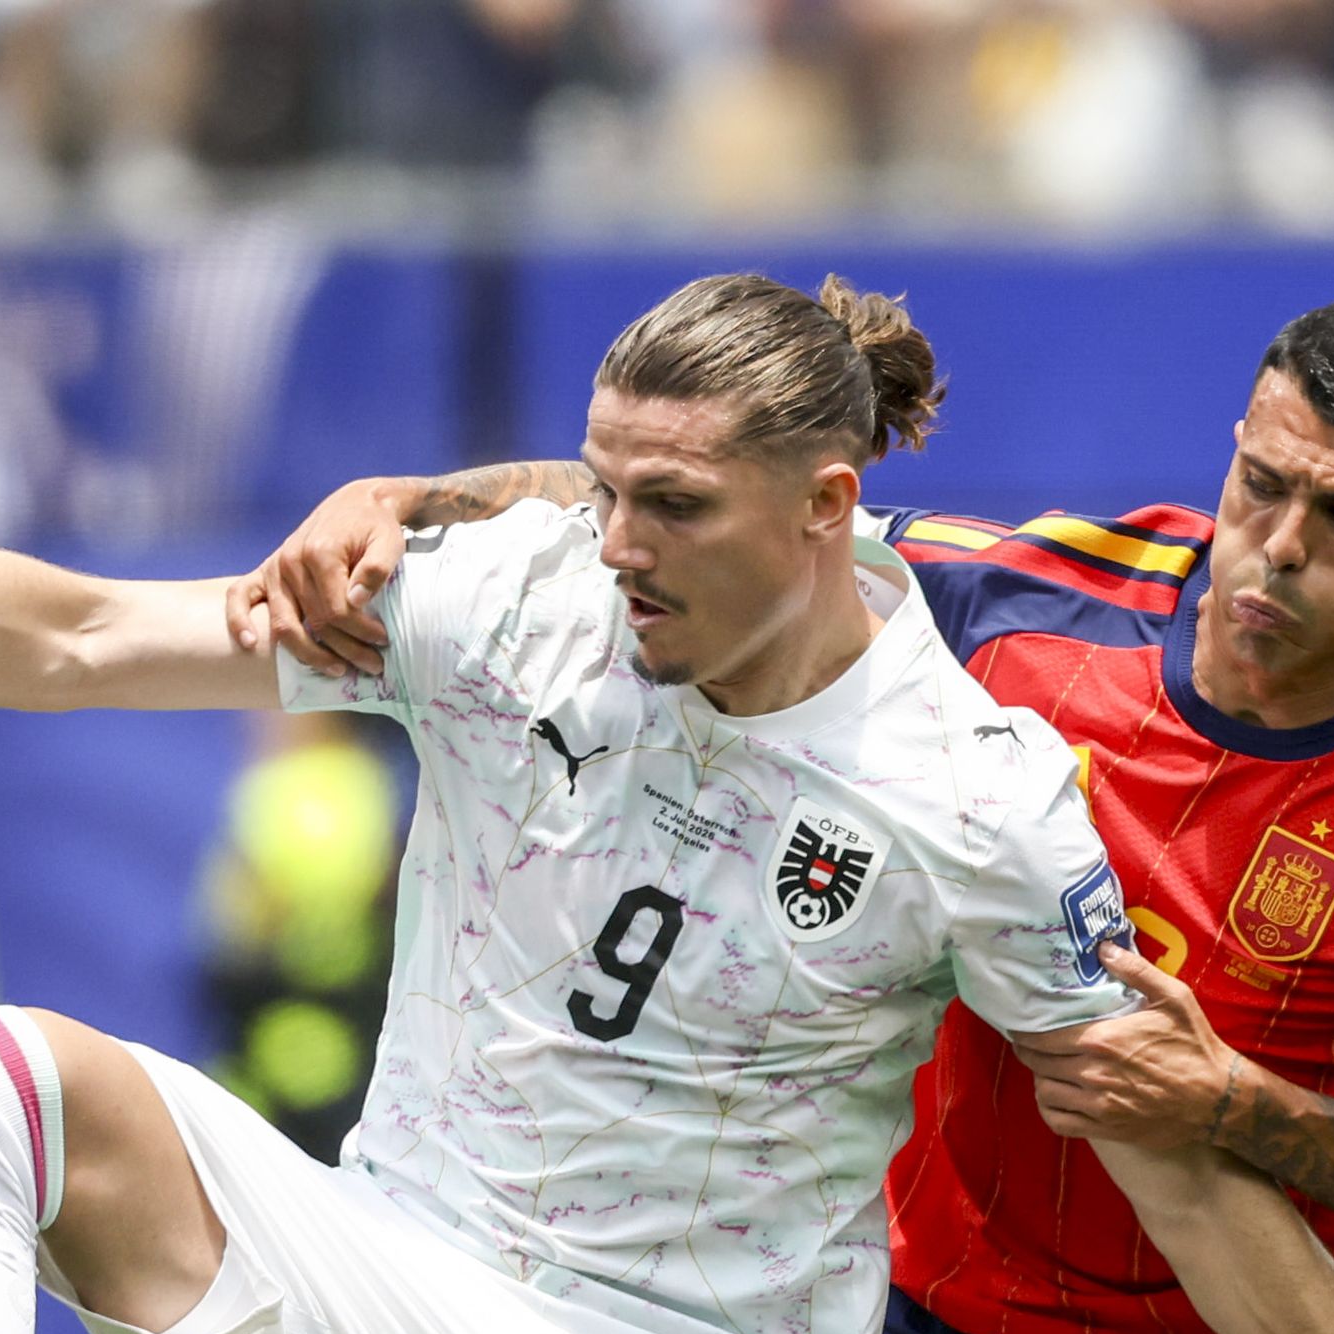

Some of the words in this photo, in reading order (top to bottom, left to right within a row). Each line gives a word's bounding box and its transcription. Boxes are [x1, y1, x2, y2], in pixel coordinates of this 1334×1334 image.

[643, 783, 683, 811] Spanien
[652, 817, 670, 832] Los
[670, 828, 710, 852] Angeles
[688, 824, 715, 841] 2026
[819, 817, 860, 844] ÖFB
[1084, 893, 1121, 938] UNITE
[566, 884, 684, 1042] 9
